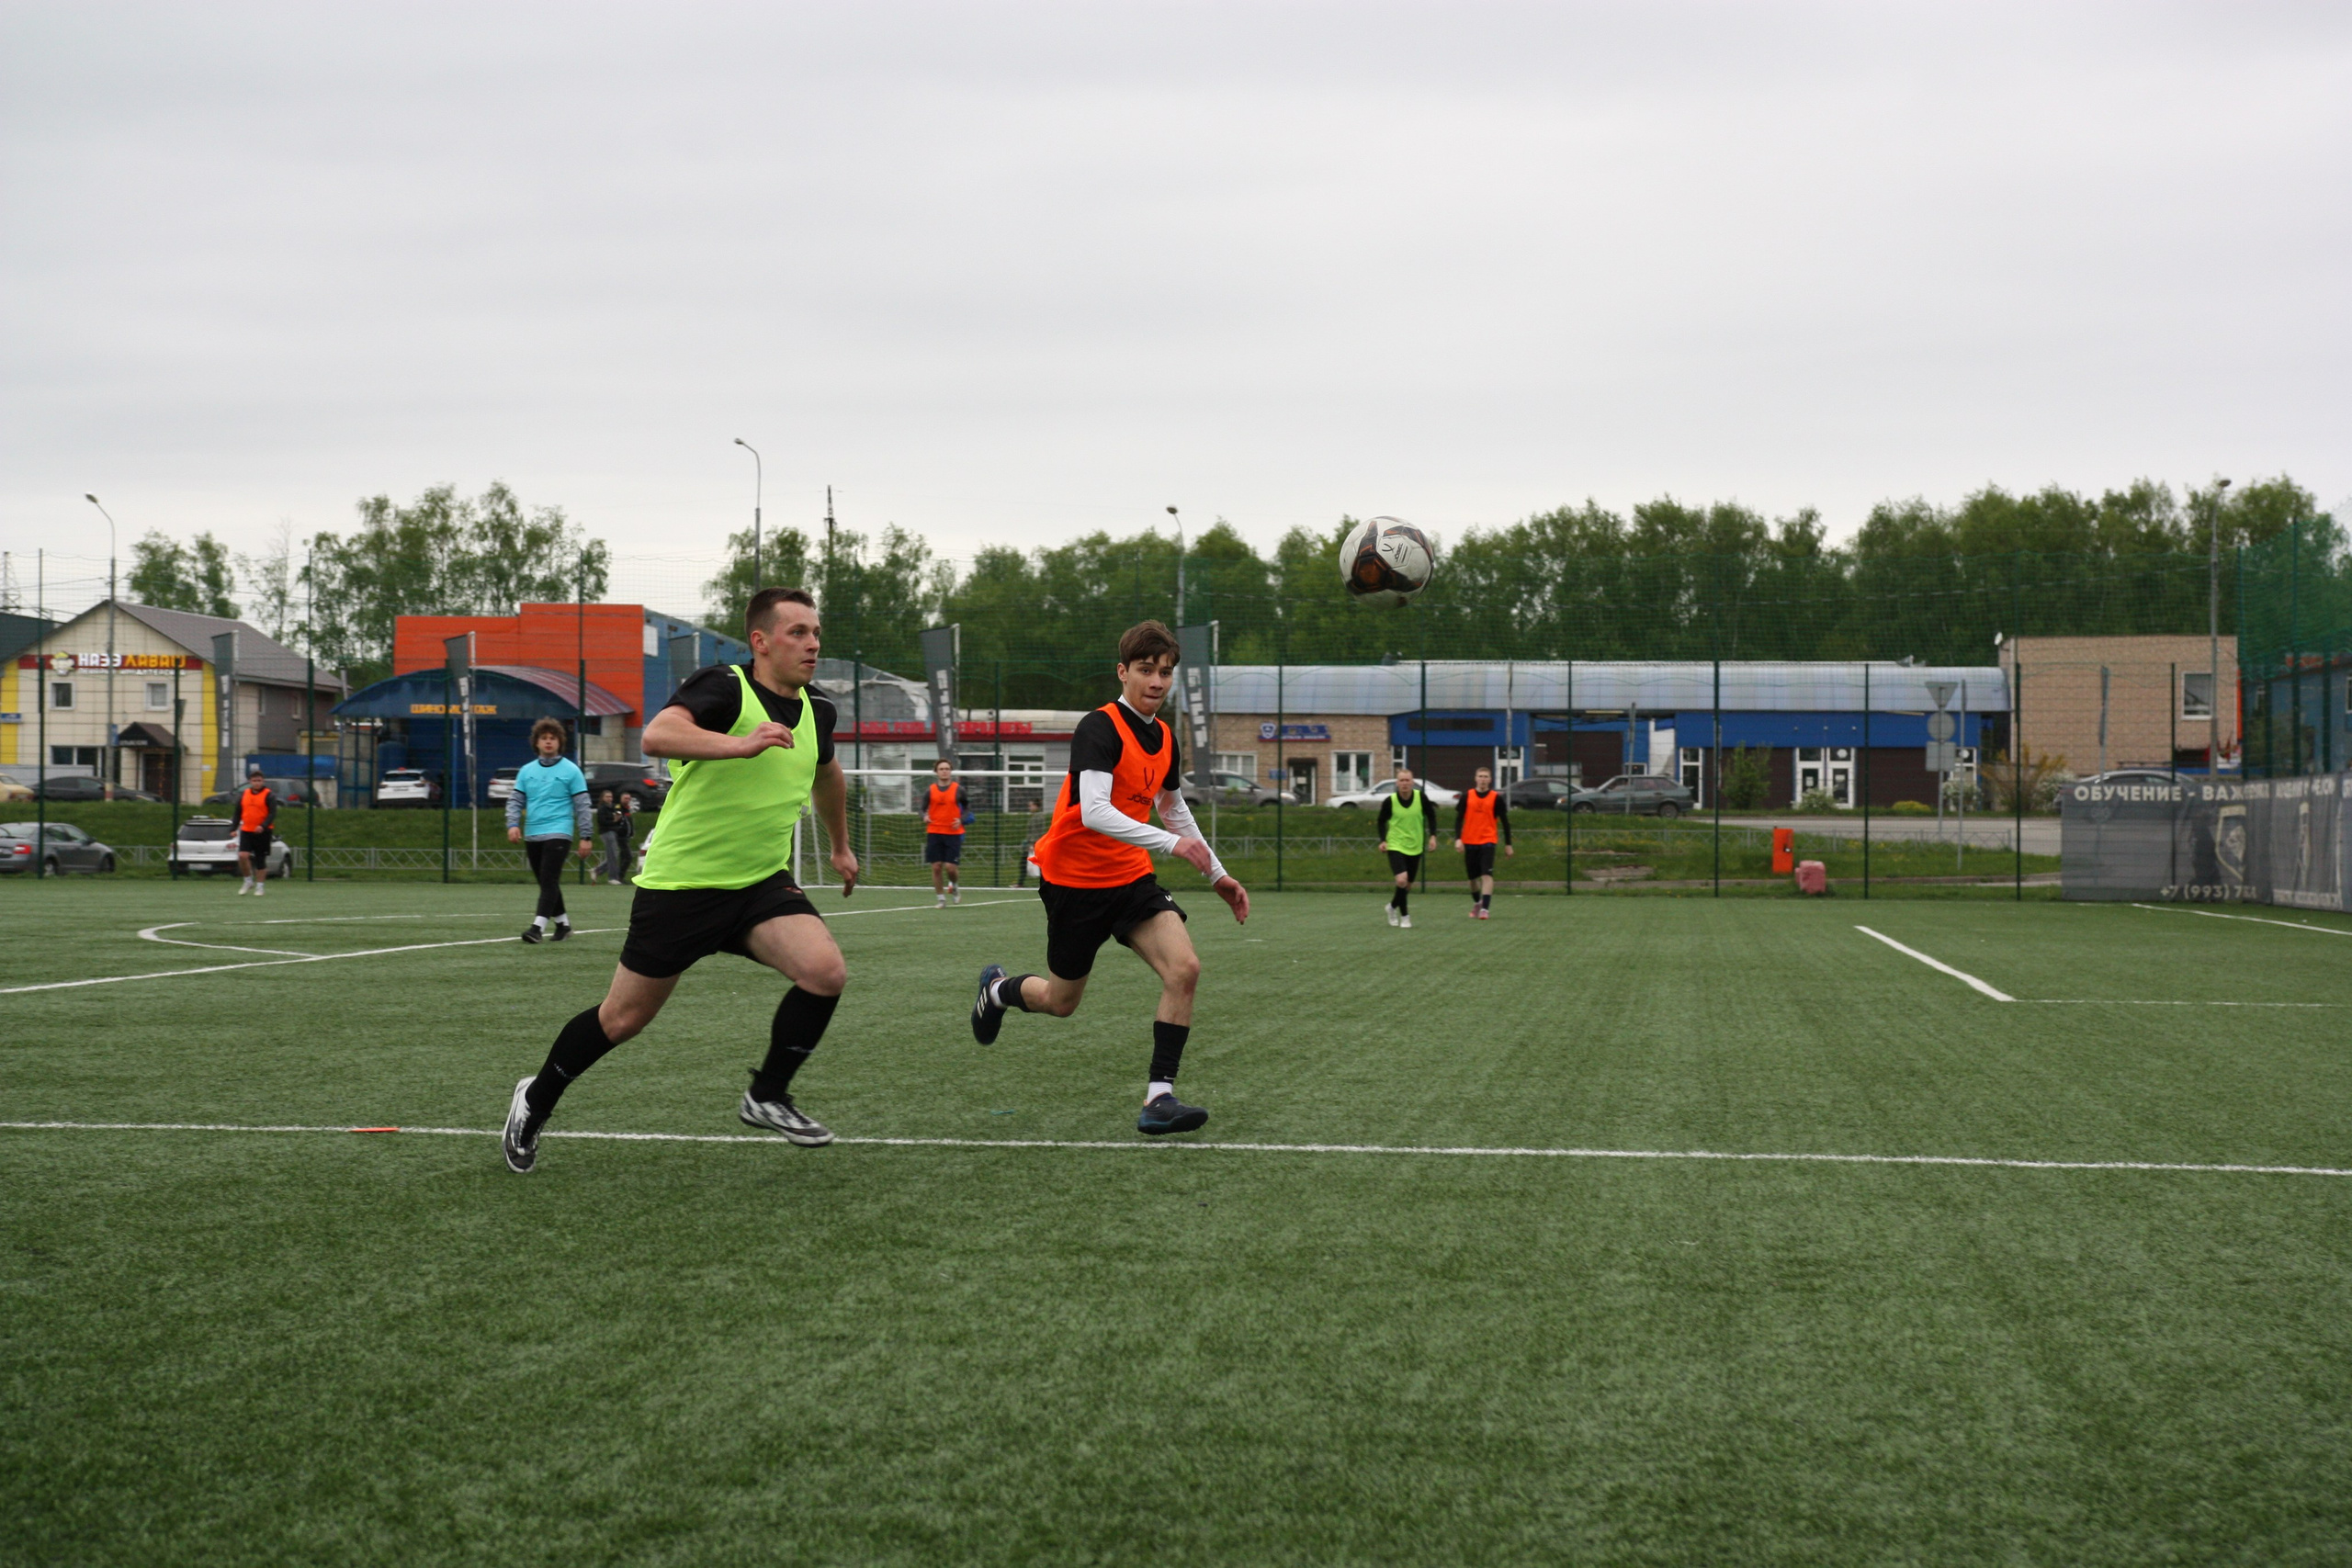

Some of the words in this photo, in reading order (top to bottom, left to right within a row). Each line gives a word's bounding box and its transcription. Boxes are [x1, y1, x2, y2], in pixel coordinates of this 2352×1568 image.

[410, 704, 497, 715] ШИНОМТАЖ
[1126, 793, 1152, 806] JÖGE
[2074, 785, 2182, 801] ОБУЧЕНИЕ
[2184, 883, 2230, 900] (993)
